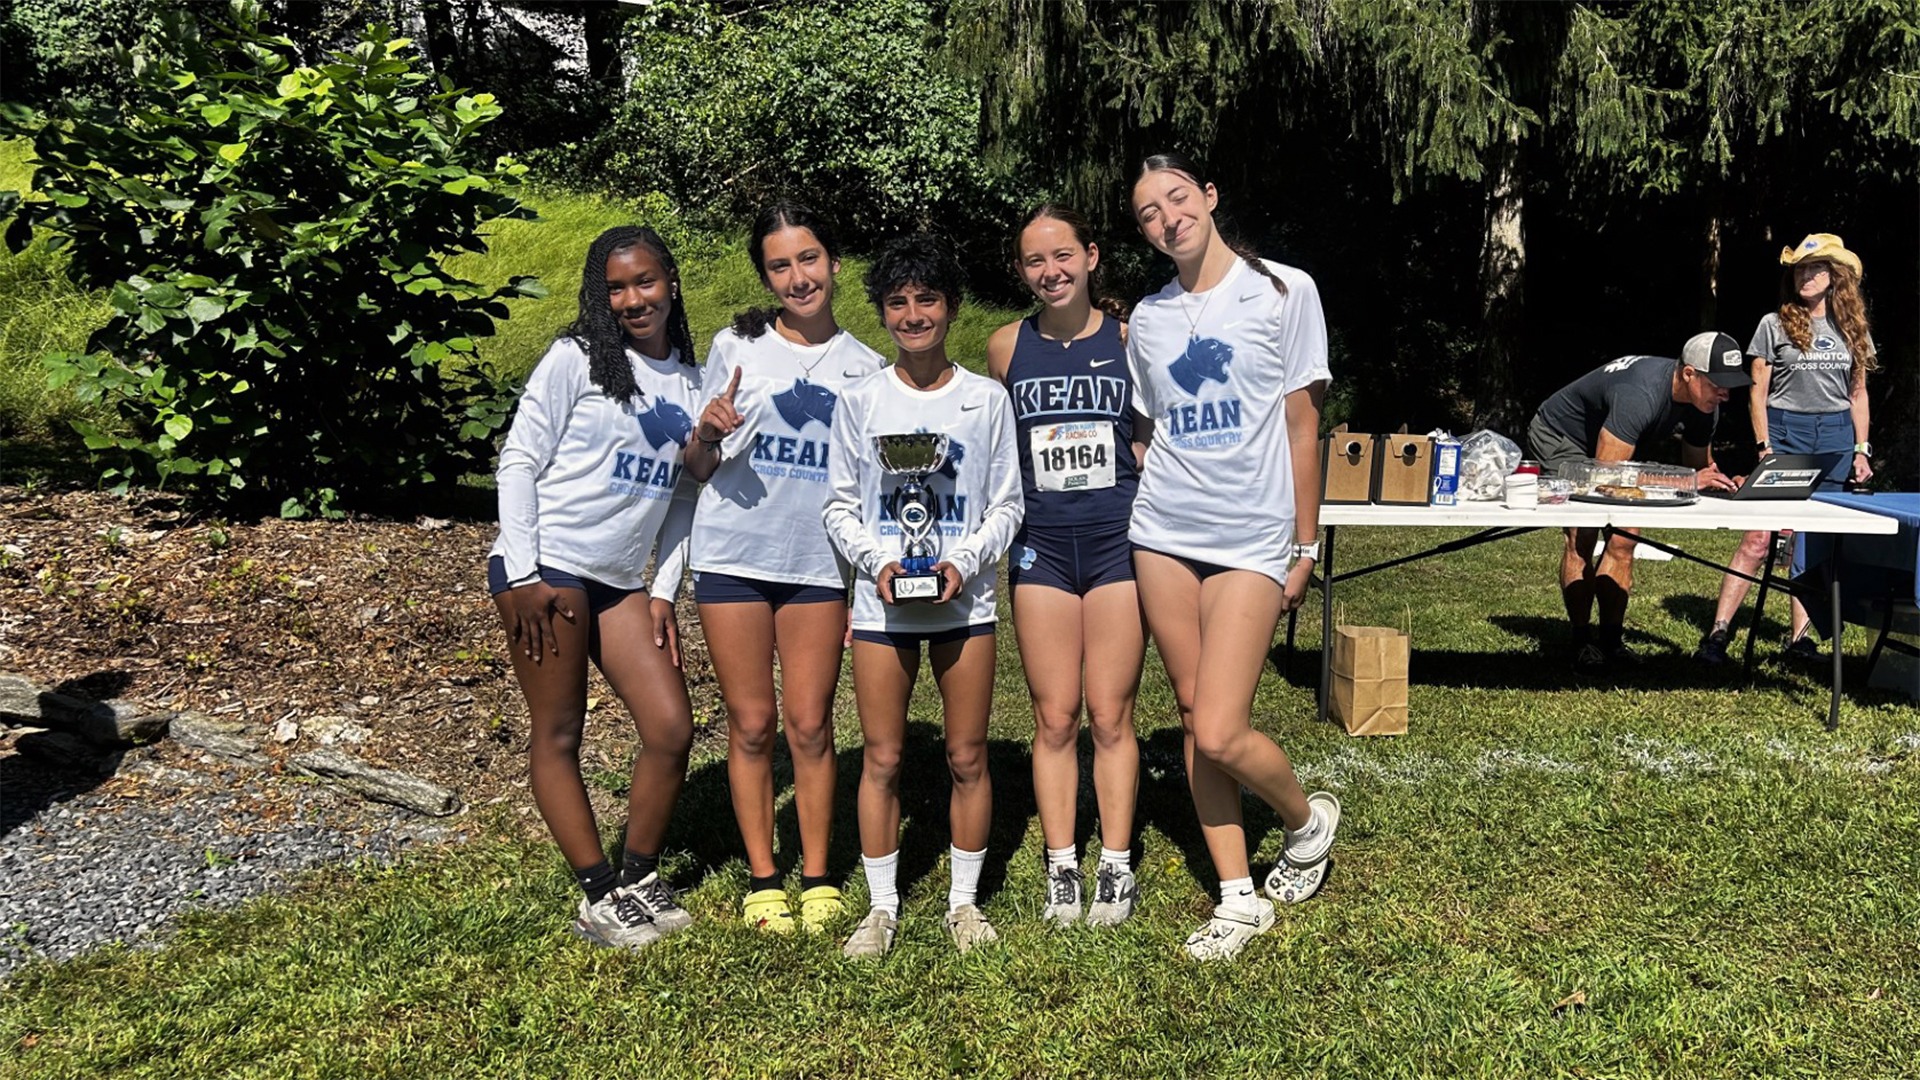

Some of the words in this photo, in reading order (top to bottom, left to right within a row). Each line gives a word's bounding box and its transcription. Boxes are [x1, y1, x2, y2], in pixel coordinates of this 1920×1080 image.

[1789, 363, 1817, 371] CROSS
[1013, 375, 1126, 420] KEAN
[1065, 430, 1088, 440] RACING
[1088, 430, 1098, 438] CO
[1194, 432, 1242, 447] COUNTRY
[1038, 443, 1108, 473] 18164
[753, 463, 788, 478] CROSS
